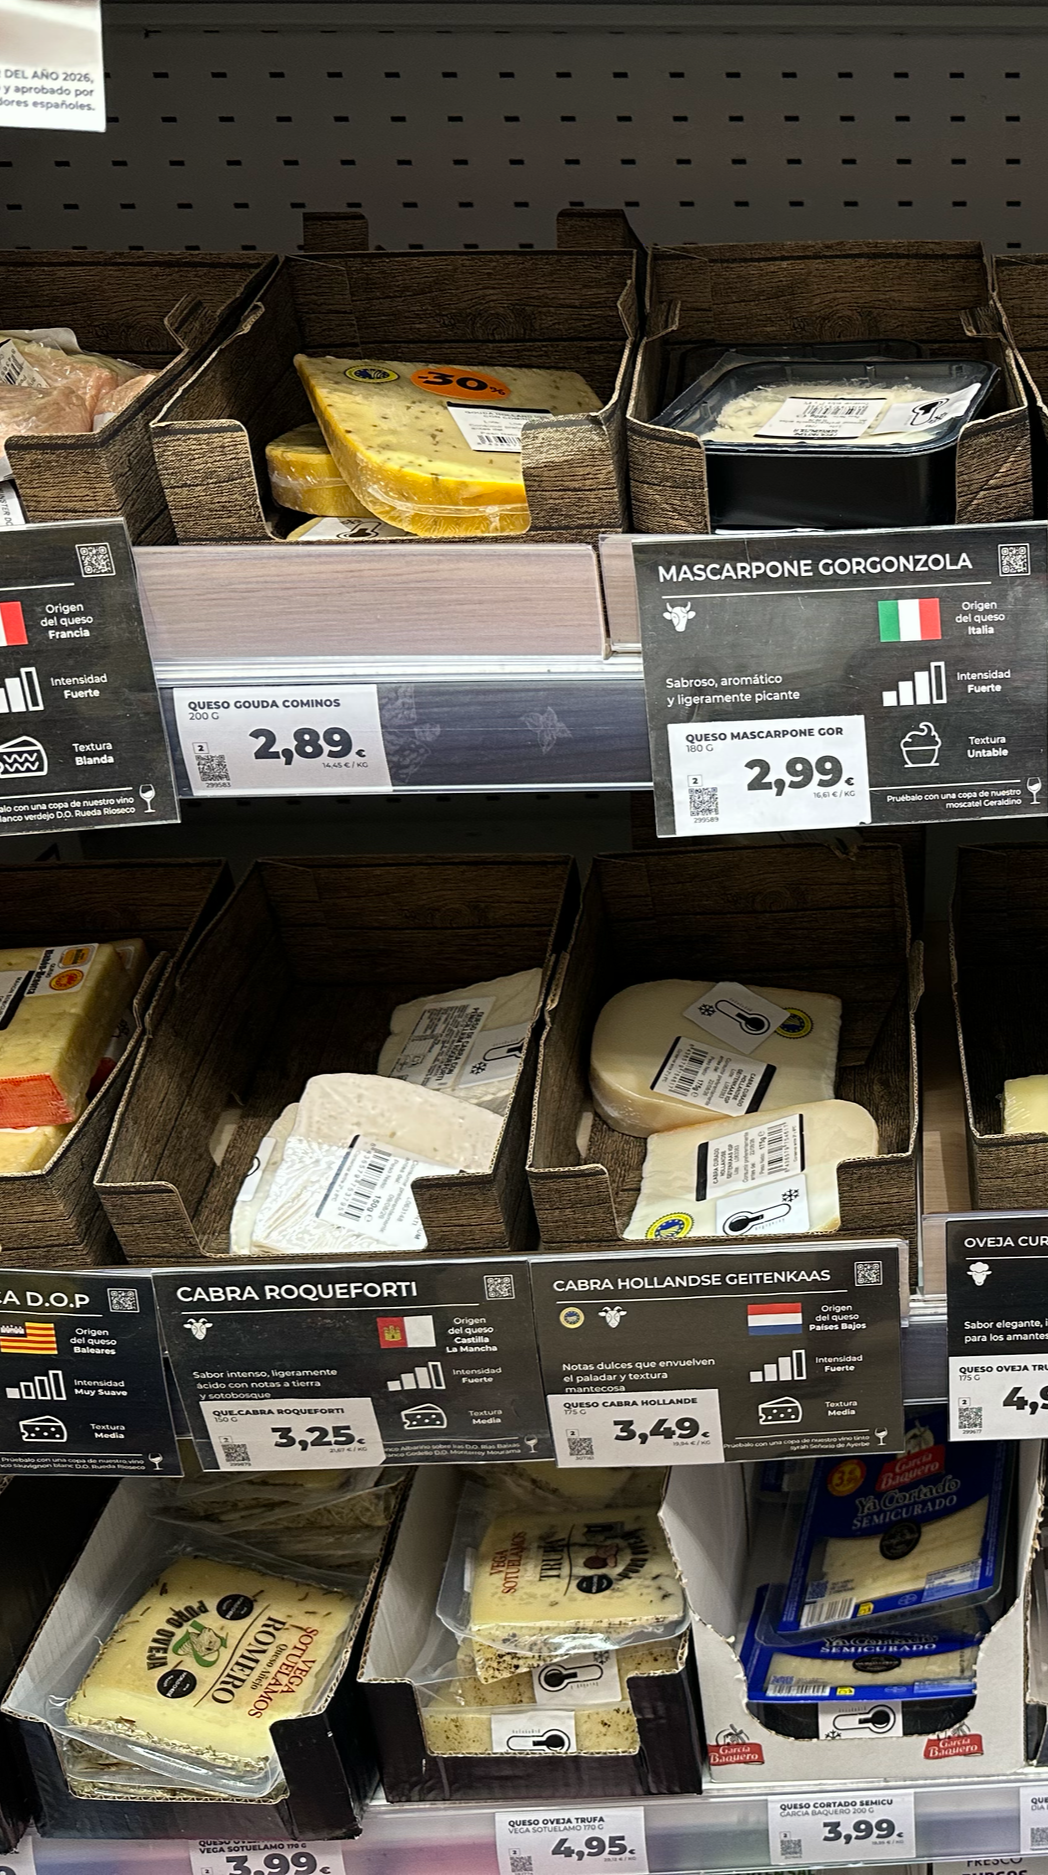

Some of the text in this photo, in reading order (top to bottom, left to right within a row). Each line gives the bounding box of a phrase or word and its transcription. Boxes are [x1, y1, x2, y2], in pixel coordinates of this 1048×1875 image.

[4, 69, 94, 84] DEL AÑO 2026,
[4, 85, 94, 98] y aprobado por
[32, 100, 95, 111] españoles.
[658, 553, 973, 582] MASCARPONE GORGONZOLA
[45, 603, 84, 614] Origen
[40, 616, 93, 627] del queso
[48, 627, 90, 639] Francia
[968, 625, 994, 635] Italia
[50, 673, 108, 686] Intensidad
[666, 673, 782, 688] Sabroso, aromático
[64, 689, 100, 699] Fuerte
[667, 690, 800, 707] y ligeramente picante
[188, 699, 341, 712] QUESO GOUDA COMINOS
[188, 712, 219, 720] 200 G
[685, 727, 843, 744] QUESO MASCARPONE GOR
[72, 742, 113, 752] Textura
[967, 747, 1009, 758] Untable
[75, 754, 114, 765] Blanda
[946, 798, 1022, 808] moscatel Geraldino
[964, 1237, 1015, 1248] OVEJA
[553, 1270, 831, 1292] CABRA HOLLANDSE GEITENKAAS
[176, 1281, 417, 1302] CABRA ROQUEFORTI
[73, 1346, 116, 1355] Baleares
[562, 1358, 715, 1371] Notas dulces que envuelven
[959, 1366, 994, 1375] QUESO
[192, 1371, 224, 1379] Sabor
[271, 1369, 337, 1378] ligeramente
[563, 1398, 698, 1410] QUESO CABRA HOLLANDE
[276, 1408, 345, 1416] ROQUEFORTI
[209, 1613, 289, 1704] ROMERO
[244, 1623, 319, 1718] SOTUELAMOS
[279, 1660, 317, 1694] VEGA
[710, 1748, 761, 1765] Baquero
[780, 1799, 893, 1811] QUESO CORTADO SEMICU
[508, 1819, 539, 1828] QUESO
[574, 1816, 605, 1824] TRUFA
